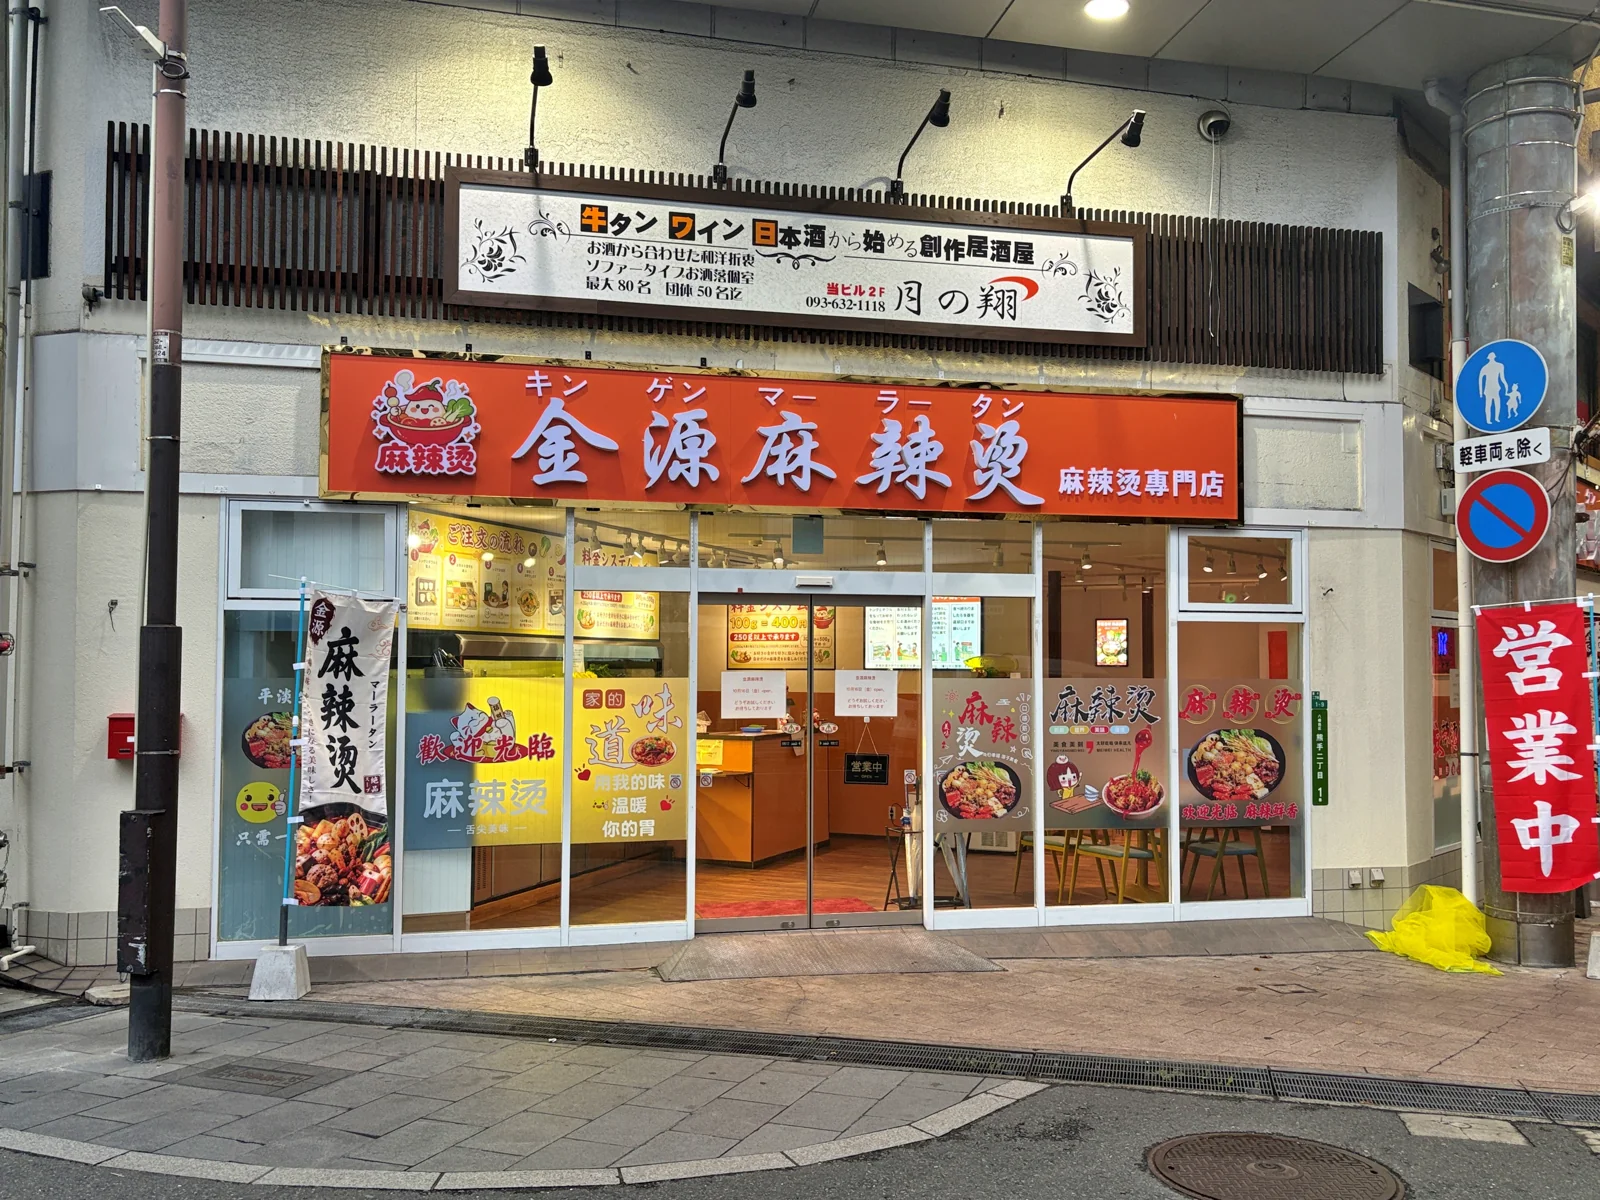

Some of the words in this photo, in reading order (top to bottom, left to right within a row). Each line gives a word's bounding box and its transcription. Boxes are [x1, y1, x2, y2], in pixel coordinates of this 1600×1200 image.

[581, 204, 658, 236] 牛タン
[669, 211, 745, 244] ワイン
[752, 218, 1035, 265] 日本酒から始める創作居酒屋
[806, 296, 886, 313] 093-632-1118
[894, 281, 1019, 322] 月の翔
[525, 371, 588, 397] キン
[646, 377, 706, 404] ゲン
[758, 385, 817, 406] マー
[877, 390, 932, 414] ラー
[972, 393, 1025, 418] タン
[376, 442, 477, 476] 麻辣烫
[511, 396, 1045, 505] 金源麻辣烫
[1459, 437, 1543, 467] 軽車両を除く
[447, 523, 525, 554] ご注文の流れ
[730, 616, 757, 630] 100g
[771, 616, 807, 629] 400円
[257, 687, 305, 706] 平淡
[317, 626, 366, 794] 麻辣烫
[584, 690, 624, 708] 家的
[1049, 684, 1161, 724] 麻辣烫
[368, 680, 381, 749] マーラータン
[416, 732, 555, 766] 歡迎光臨
[1493, 619, 1584, 877] 営業中
[850, 761, 883, 773] 営業中
[423, 778, 548, 819] 麻辣烫
[611, 796, 648, 815] 温暖
[235, 828, 299, 848] 只需一
[602, 819, 656, 838] 你的胃
